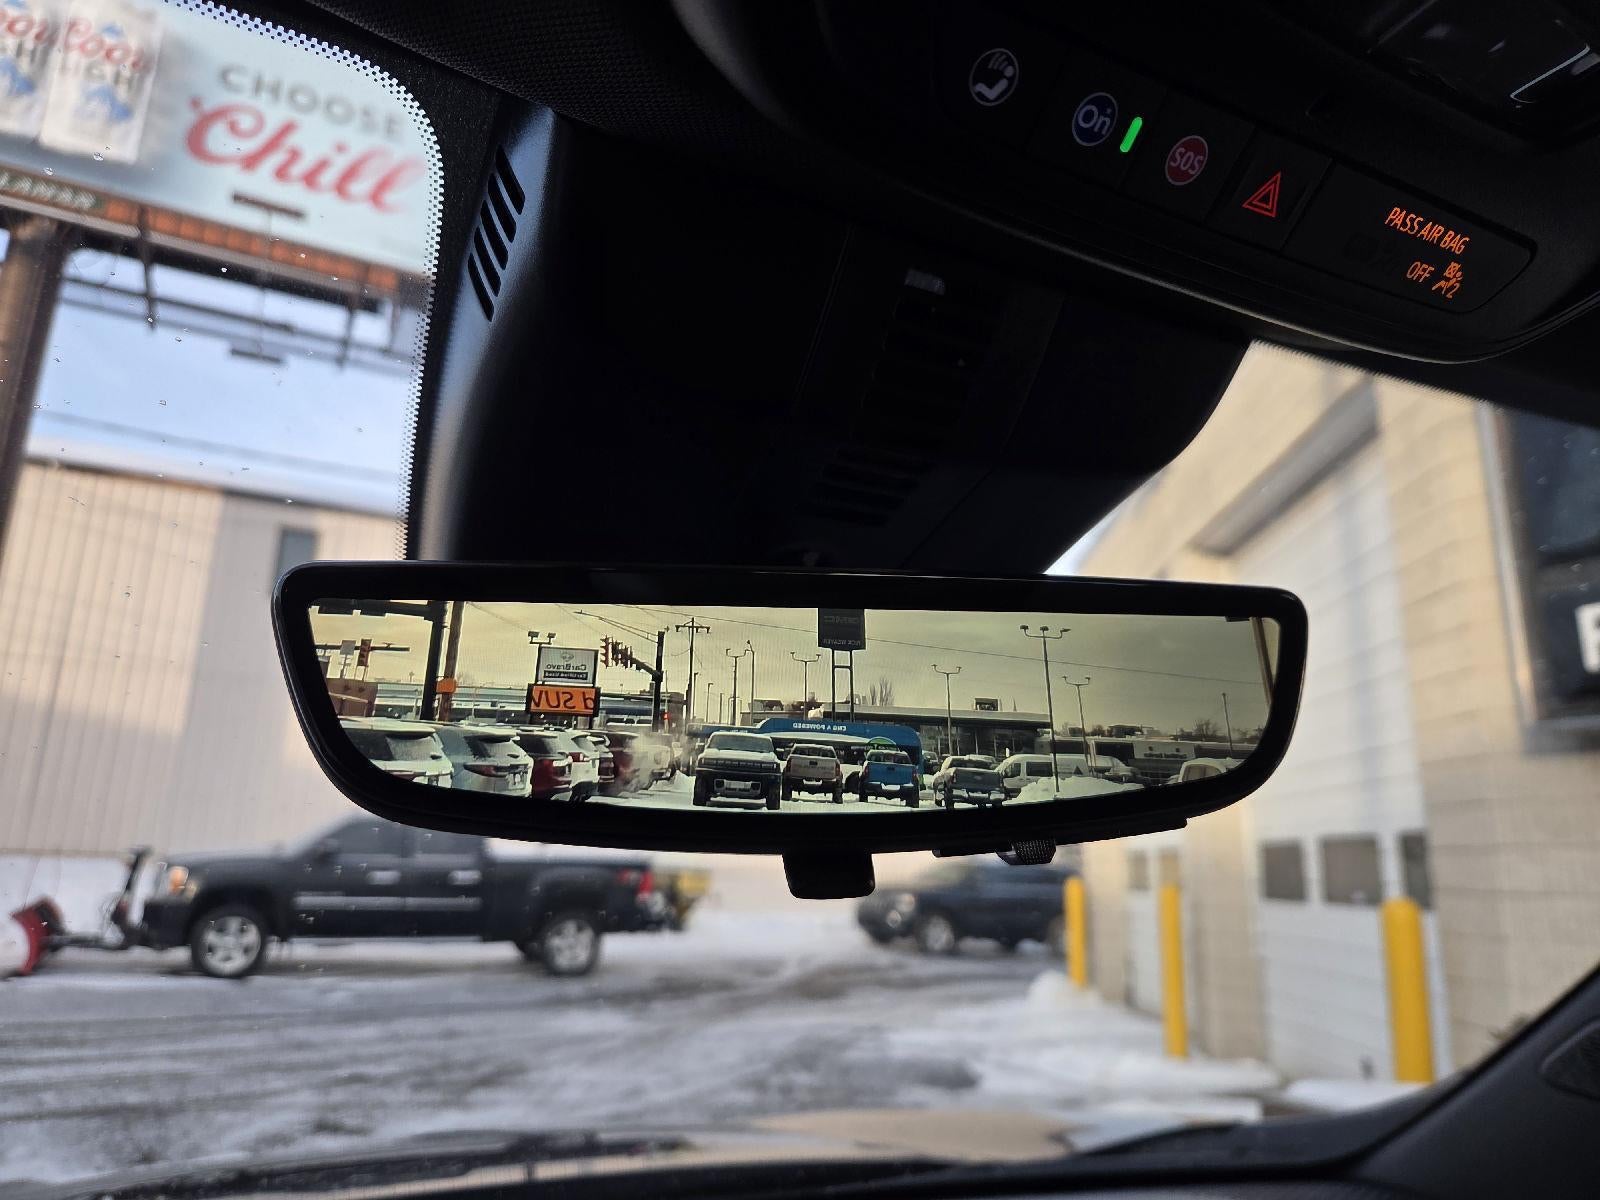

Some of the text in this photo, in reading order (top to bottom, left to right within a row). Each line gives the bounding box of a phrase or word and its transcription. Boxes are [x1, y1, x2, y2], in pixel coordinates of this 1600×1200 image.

[63, 17, 152, 72] Coo
[219, 64, 400, 140] CHOOSE
[186, 98, 424, 213] Chill
[1169, 147, 1204, 175] SOS
[1384, 207, 1470, 255] PASS AIR BAG
[1406, 261, 1435, 283] OFF
